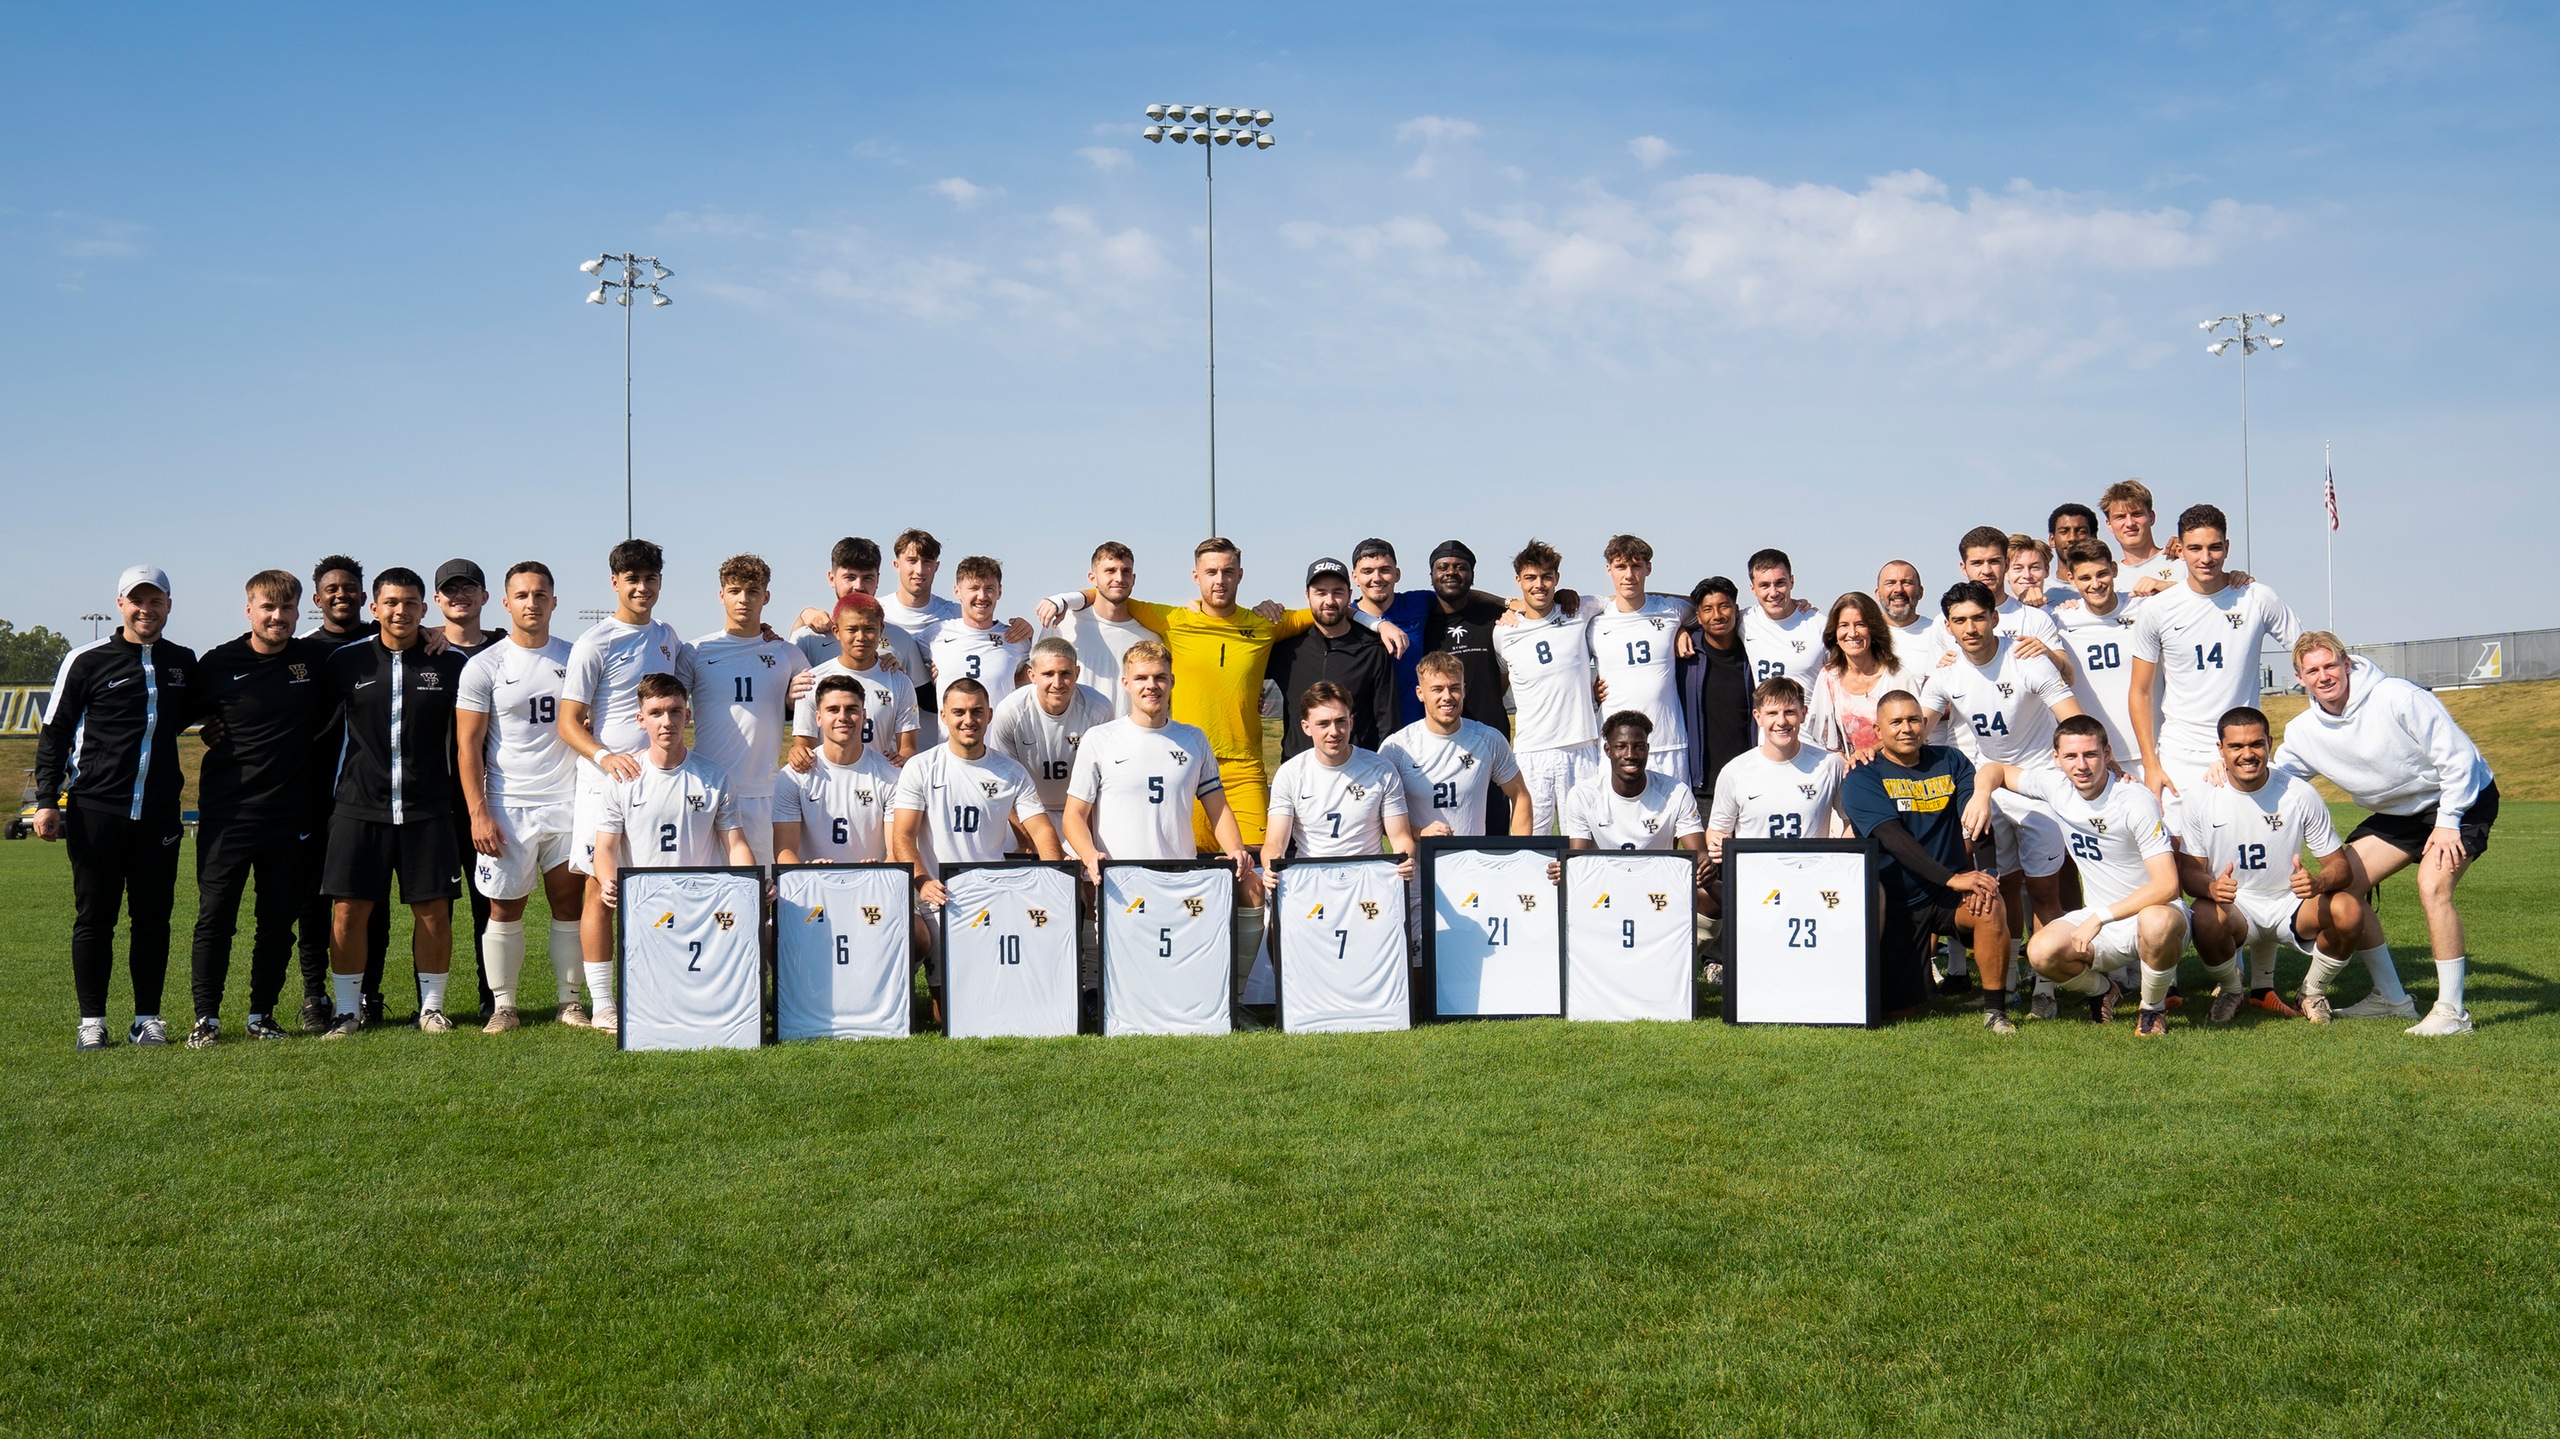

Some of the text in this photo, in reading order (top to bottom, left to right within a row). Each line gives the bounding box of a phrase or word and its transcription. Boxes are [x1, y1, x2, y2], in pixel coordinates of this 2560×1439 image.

[1313, 562, 1342, 574] SURF
[1218, 643, 1226, 668] 1
[1535, 640, 1553, 665] 8
[1625, 640, 1651, 665] 13
[2087, 642, 2121, 671] 20
[2195, 642, 2224, 670] 14
[289, 663, 307, 680] WP
[965, 655, 981, 679] 3
[1757, 660, 1786, 683] 22
[734, 676, 754, 702] 11
[529, 696, 556, 724] 19
[1972, 711, 2009, 737] 24
[1043, 760, 1068, 780] 16
[1147, 776, 1165, 804] 5
[1433, 781, 1458, 809] 21
[954, 805, 980, 833] 10
[1917, 799, 1942, 811] SOCCER
[660, 823, 677, 852] 2
[831, 817, 848, 844] 6
[1326, 813, 1342, 839] 7
[1768, 812, 1802, 839] 23
[2070, 832, 2103, 861] 25
[2238, 843, 2267, 870] 12
[1159, 928, 1172, 957] 5
[1335, 930, 1348, 959] 7
[1488, 917, 1508, 946] 21
[1622, 919, 1635, 948] 9
[1788, 918, 1817, 948] 23
[687, 941, 702, 972] 2
[836, 935, 849, 965] 6
[1000, 935, 1020, 965] 10
